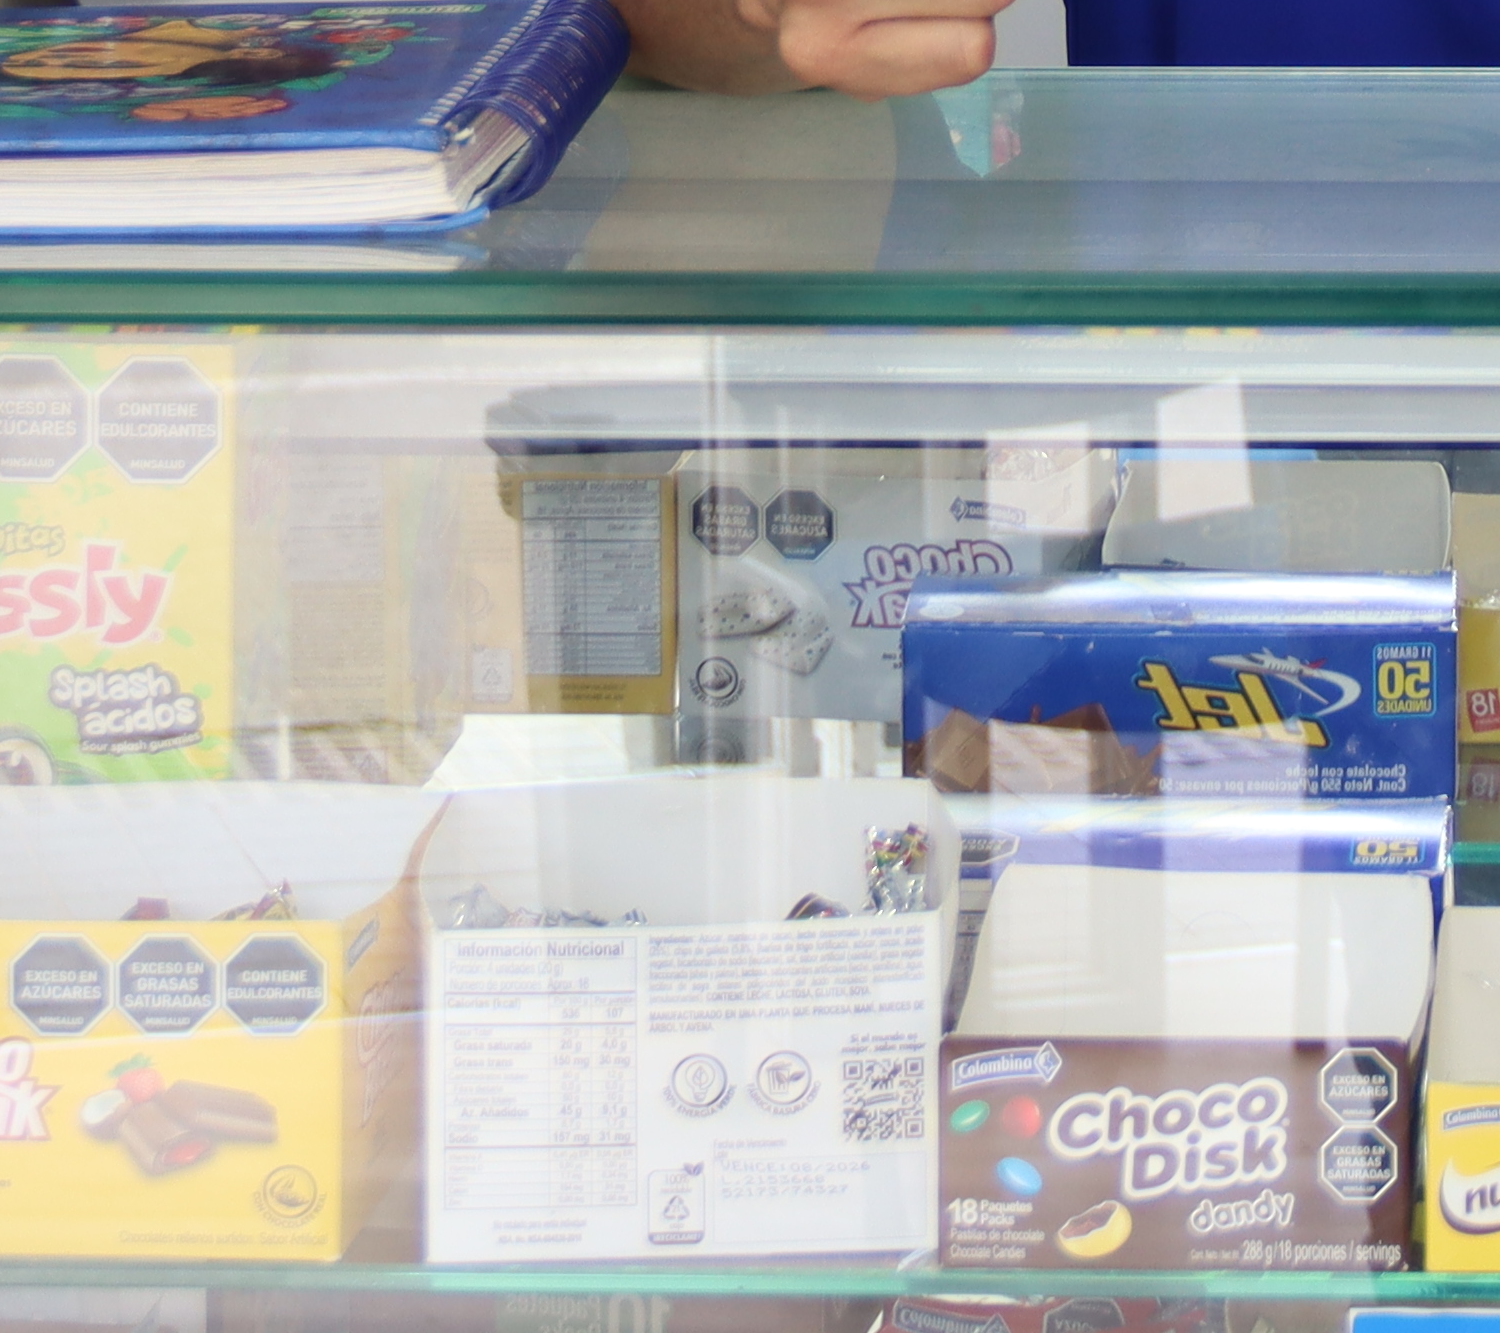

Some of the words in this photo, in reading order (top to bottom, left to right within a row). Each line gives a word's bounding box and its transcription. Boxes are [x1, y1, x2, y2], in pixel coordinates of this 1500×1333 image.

[50, 664, 172, 705] Splash
[81, 693, 199, 735] ácidos
[456, 941, 542, 958] Información
[547, 940, 625, 957] Nutricional
[25, 970, 76, 983] EXCESO
[80, 970, 98, 982] EN
[136, 976, 199, 992] GRASAS
[242, 970, 308, 984] CONTIENE
[22, 982, 102, 1000] AZÚCARES
[227, 985, 323, 1001] EDULCORANTES
[124, 992, 212, 1009] SATURADAS
[957, 1054, 1033, 1079] Colombina
[1051, 1082, 1284, 1158] Choco
[1125, 1125, 1284, 1197] Disk
[948, 1199, 978, 1224] 18
[980, 1200, 1033, 1214] Paquetes
[981, 1213, 1015, 1225] Packs
[1191, 1189, 1296, 1232] dandy
